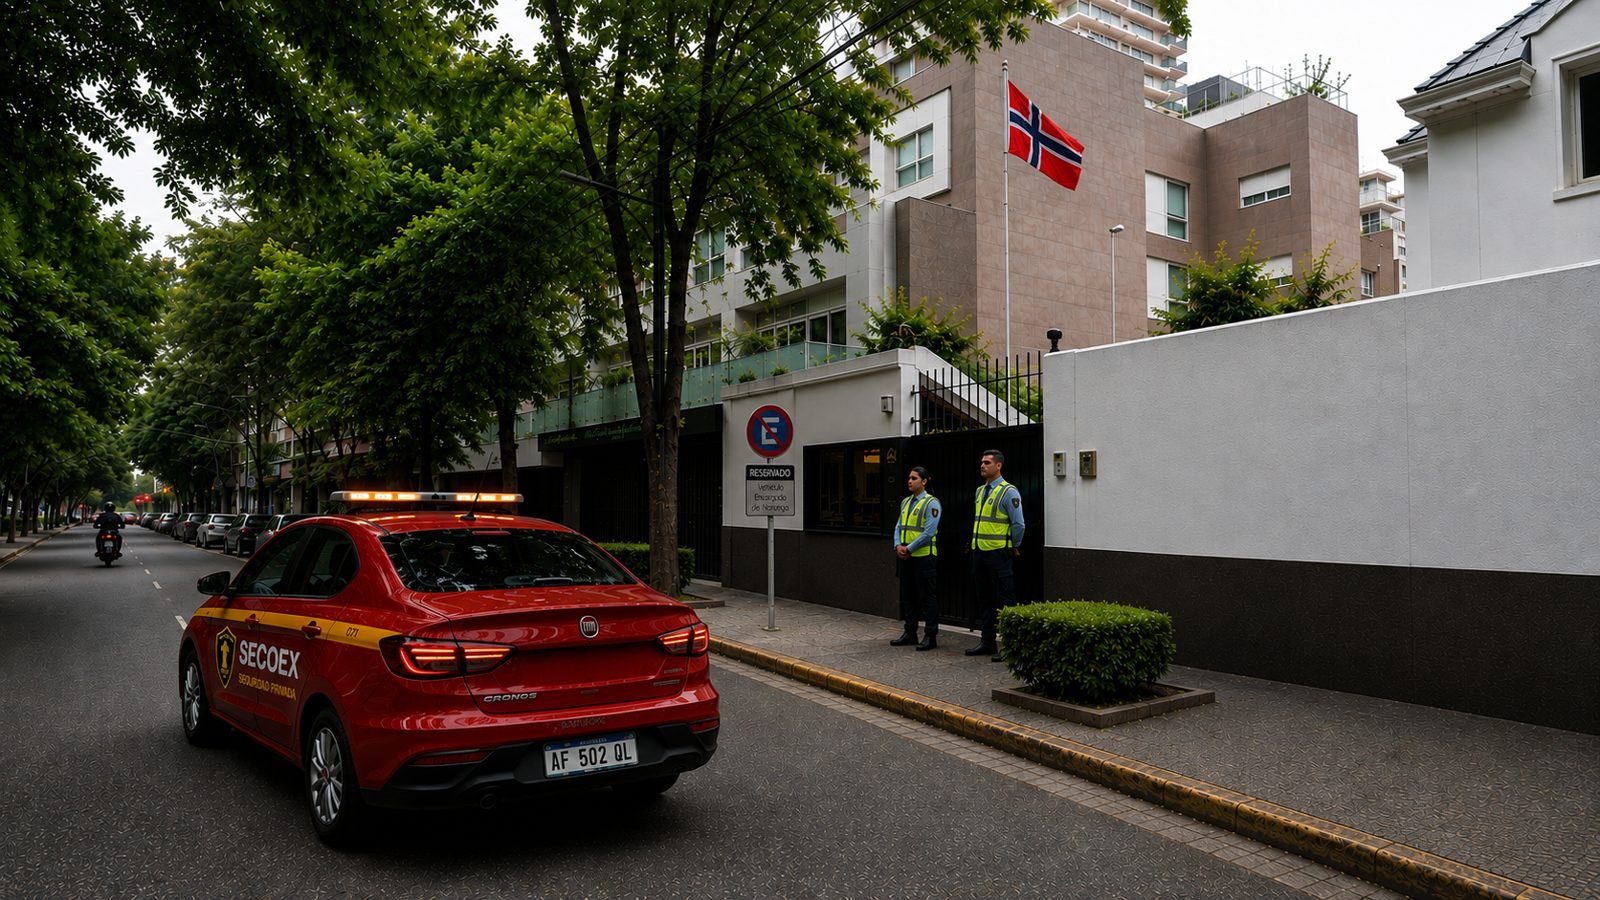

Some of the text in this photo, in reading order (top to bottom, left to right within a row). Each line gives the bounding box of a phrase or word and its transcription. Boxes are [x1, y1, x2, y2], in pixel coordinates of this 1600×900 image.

[749, 468, 791, 478] RESERVADO
[239, 640, 300, 680] SECOEX
[483, 692, 538, 703] CRONOS
[551, 743, 632, 770] AF 502 QL
